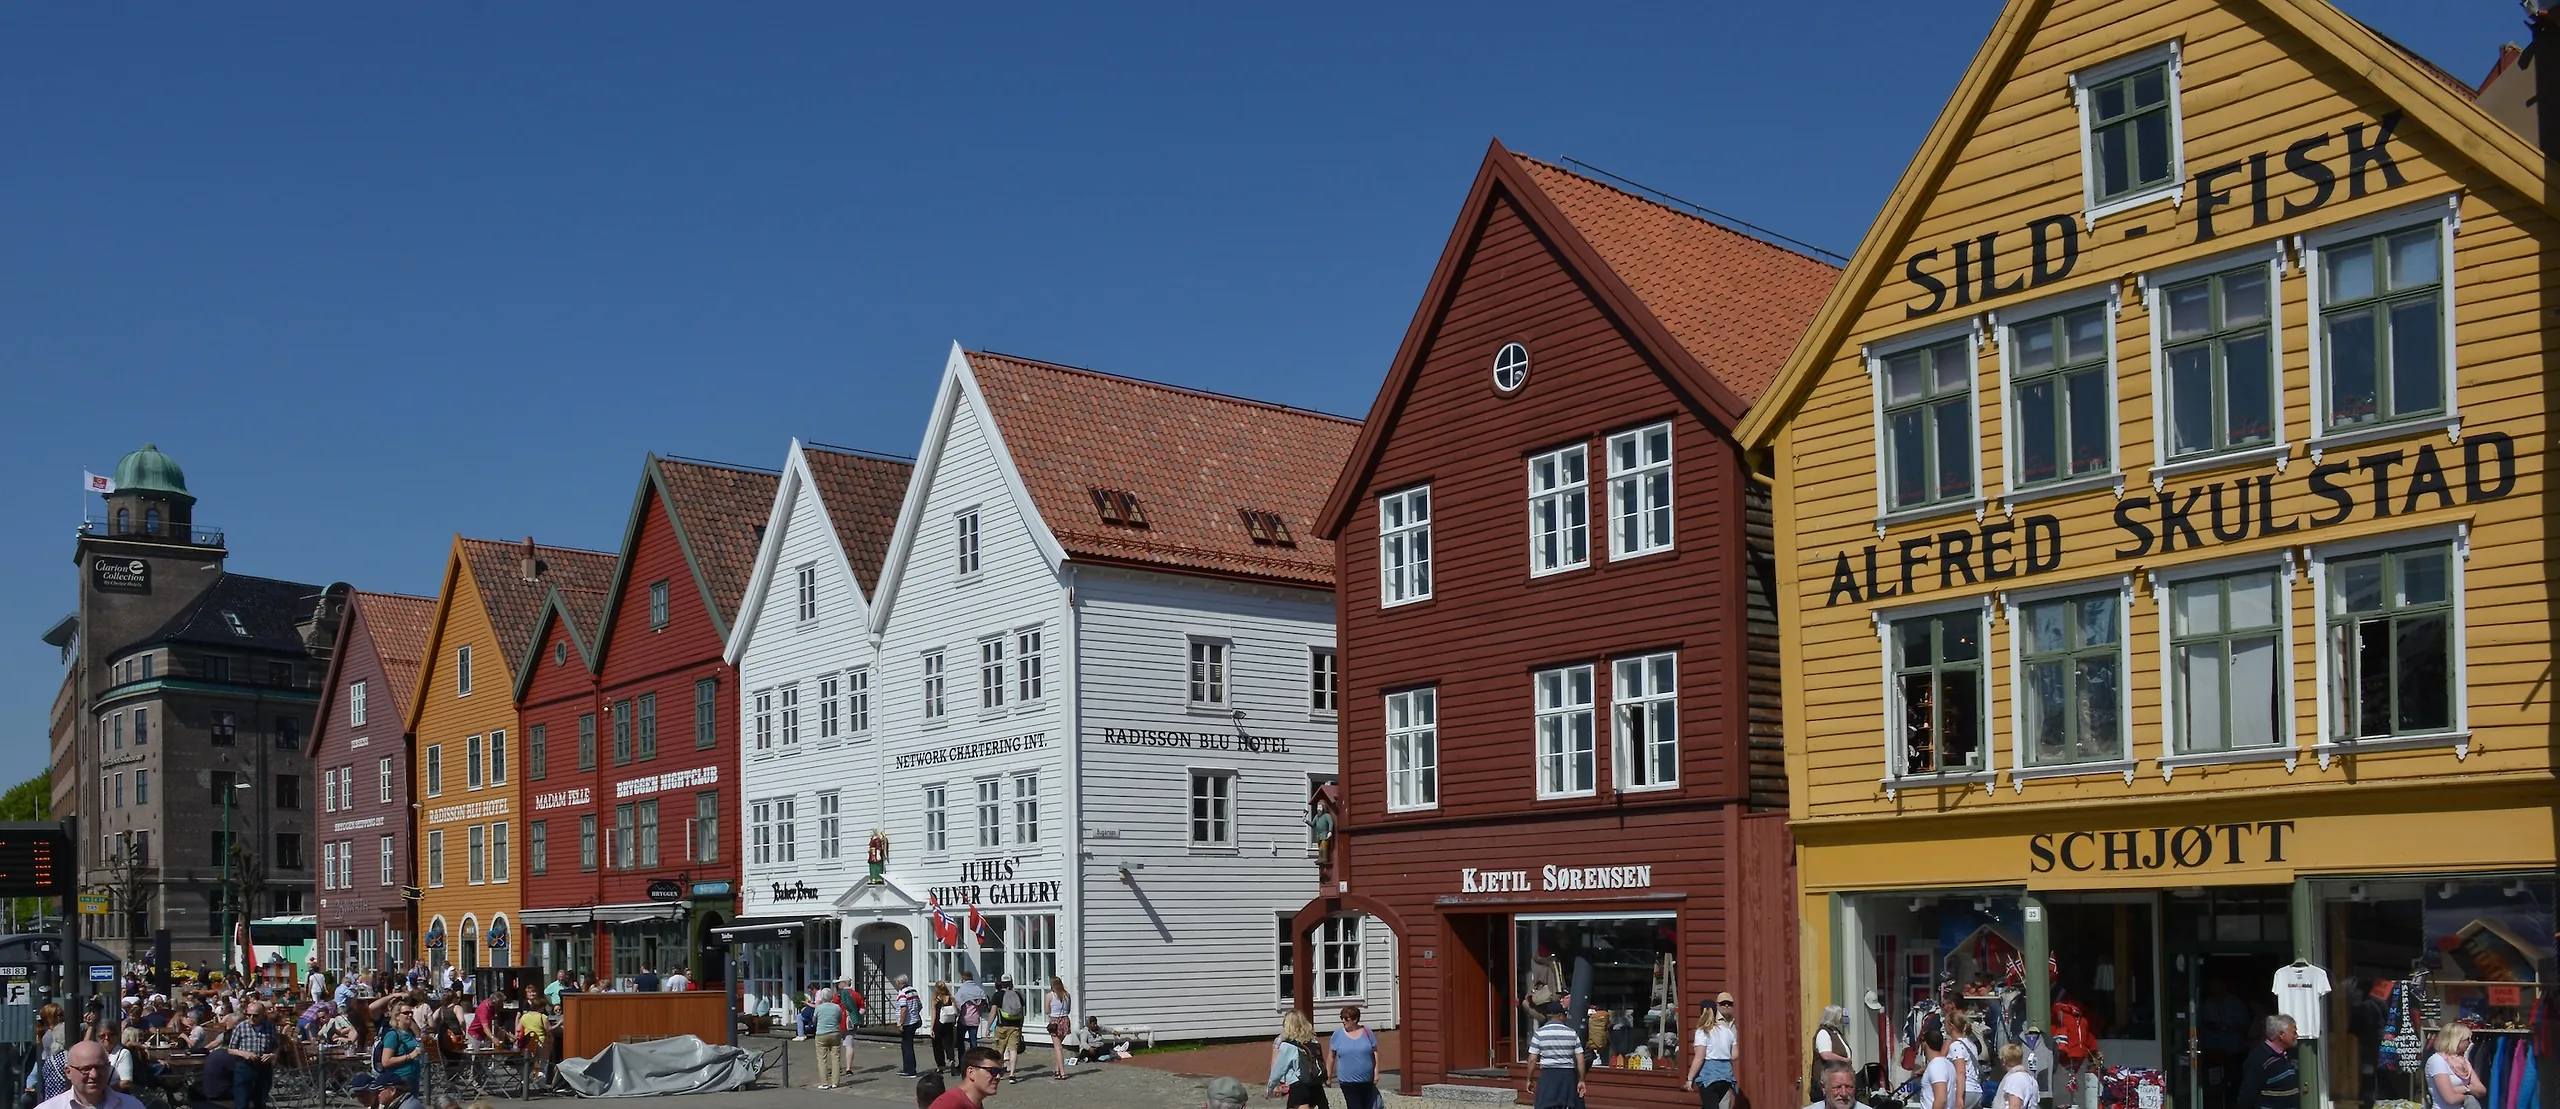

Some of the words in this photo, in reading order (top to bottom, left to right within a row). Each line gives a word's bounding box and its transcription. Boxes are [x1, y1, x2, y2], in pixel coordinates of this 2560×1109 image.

[1905, 214, 2080, 319] SILD
[2194, 110, 2410, 243] FISK
[1826, 514, 2062, 607] ALFRED
[2113, 432, 2517, 560] SKULSTAD
[95, 559, 129, 573] Clarion
[103, 572, 145, 581] Collection
[896, 749, 947, 769] NETWORK
[949, 736, 1022, 761] CHARTERING
[1024, 732, 1048, 750] INT.
[1104, 727, 1191, 748] RADISSON
[1199, 733, 1230, 750] BLU
[1236, 734, 1290, 753] HOTEL
[616, 776, 659, 799] BRYGGEN
[660, 765, 719, 791] NIGHTCLUB
[429, 804, 466, 825] RADISSON
[466, 801, 482, 819] BLU
[483, 797, 510, 817] HOTEL
[535, 791, 566, 810] MADAM
[568, 788, 591, 805] FELLE
[2030, 820, 2295, 874] SCHJØTT
[929, 885, 981, 906] SILVER
[989, 880, 1061, 905] GALLERY
[1461, 868, 1531, 894] KJETIL
[1542, 864, 1651, 892] SØRENSEN
